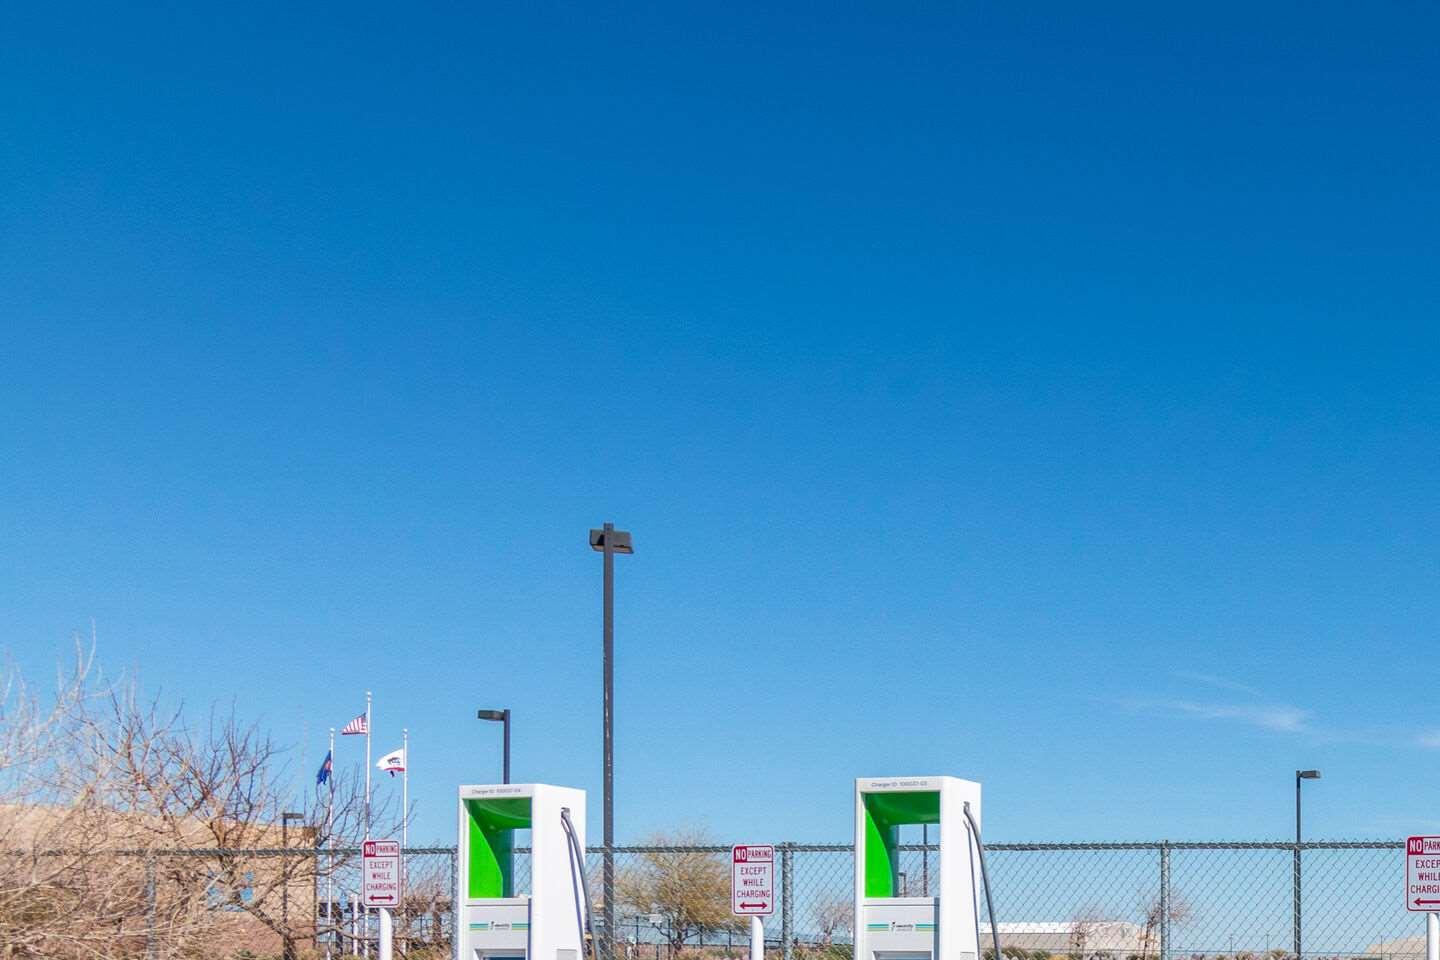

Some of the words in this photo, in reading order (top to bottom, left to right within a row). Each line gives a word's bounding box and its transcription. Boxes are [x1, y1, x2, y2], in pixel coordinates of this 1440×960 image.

[365, 843, 376, 855] NO
[1409, 839, 1423, 853] NO
[735, 848, 747, 860] NO
[748, 850, 772, 858] PARKING
[369, 861, 393, 869] EXCEPT
[740, 867, 767, 875] EXCEPT
[372, 872, 392, 880] WHILE
[743, 878, 765, 887] WHILE
[366, 883, 396, 891] CHARGING
[737, 890, 771, 898] CHARGING
